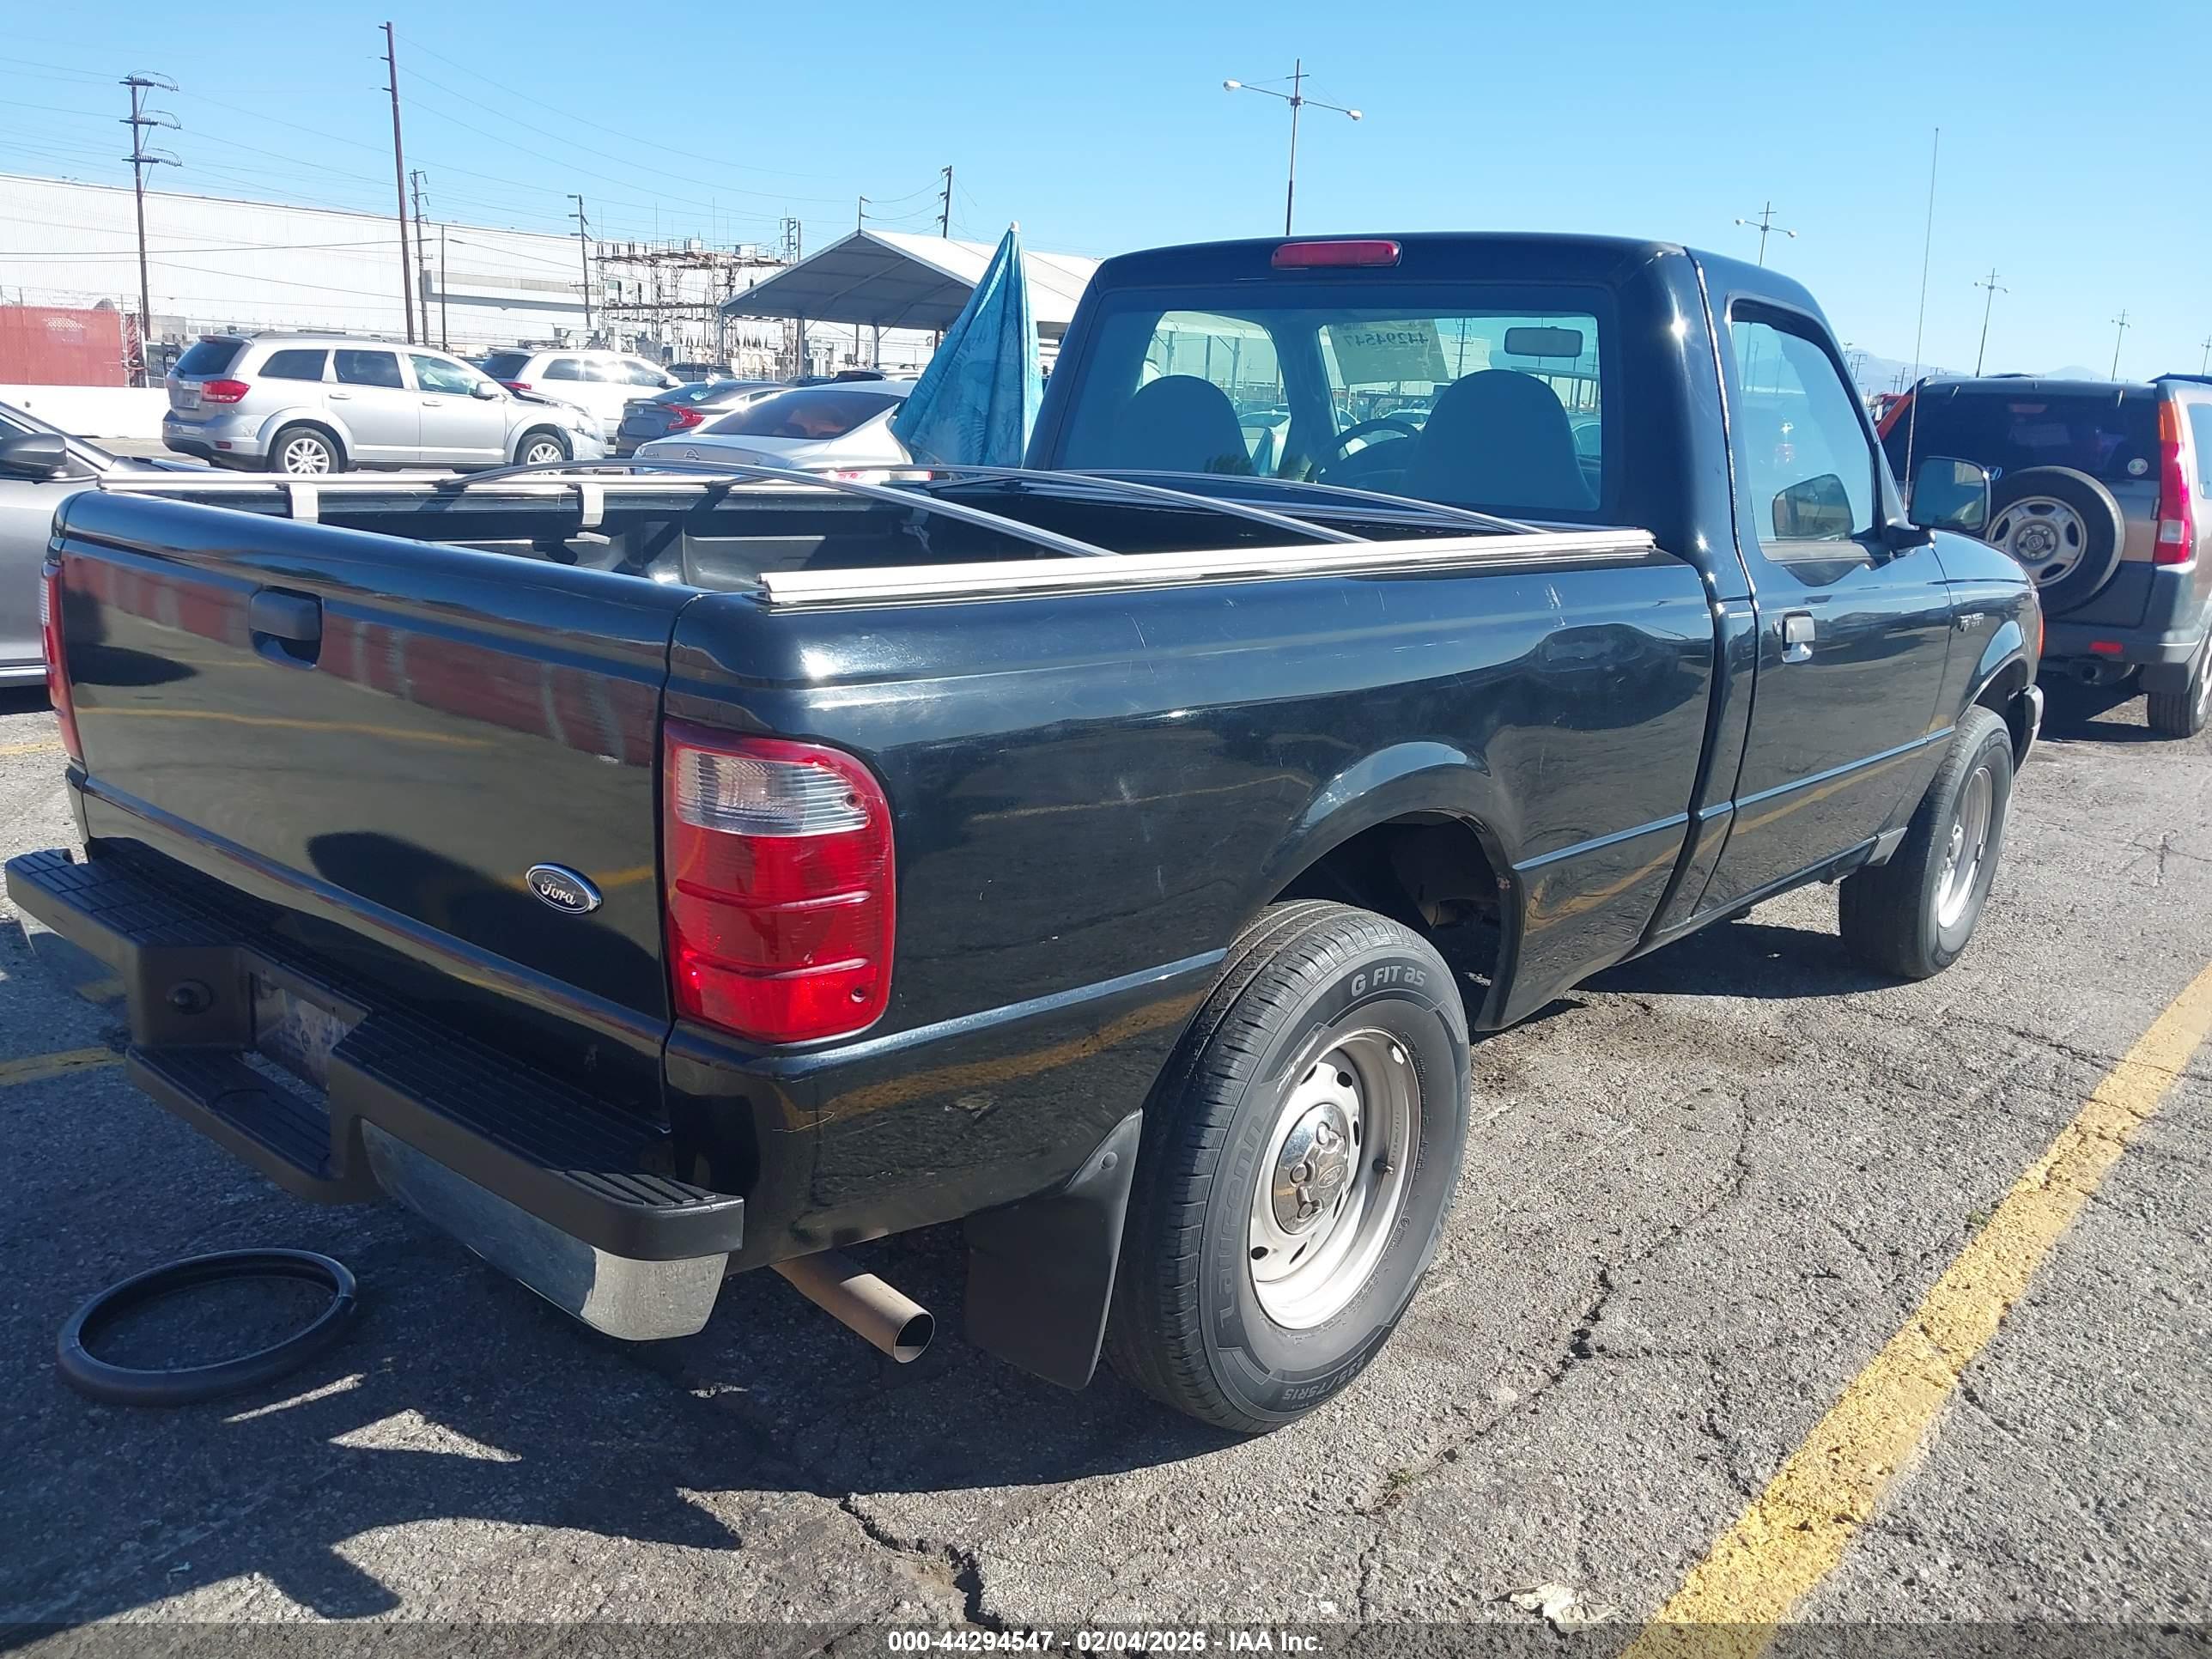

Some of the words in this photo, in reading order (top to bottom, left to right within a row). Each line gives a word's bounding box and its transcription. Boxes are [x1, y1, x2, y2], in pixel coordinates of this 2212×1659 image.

[540, 874, 577, 905] Ford
[1352, 974, 1366, 996] G
[1372, 965, 1402, 987] FIT
